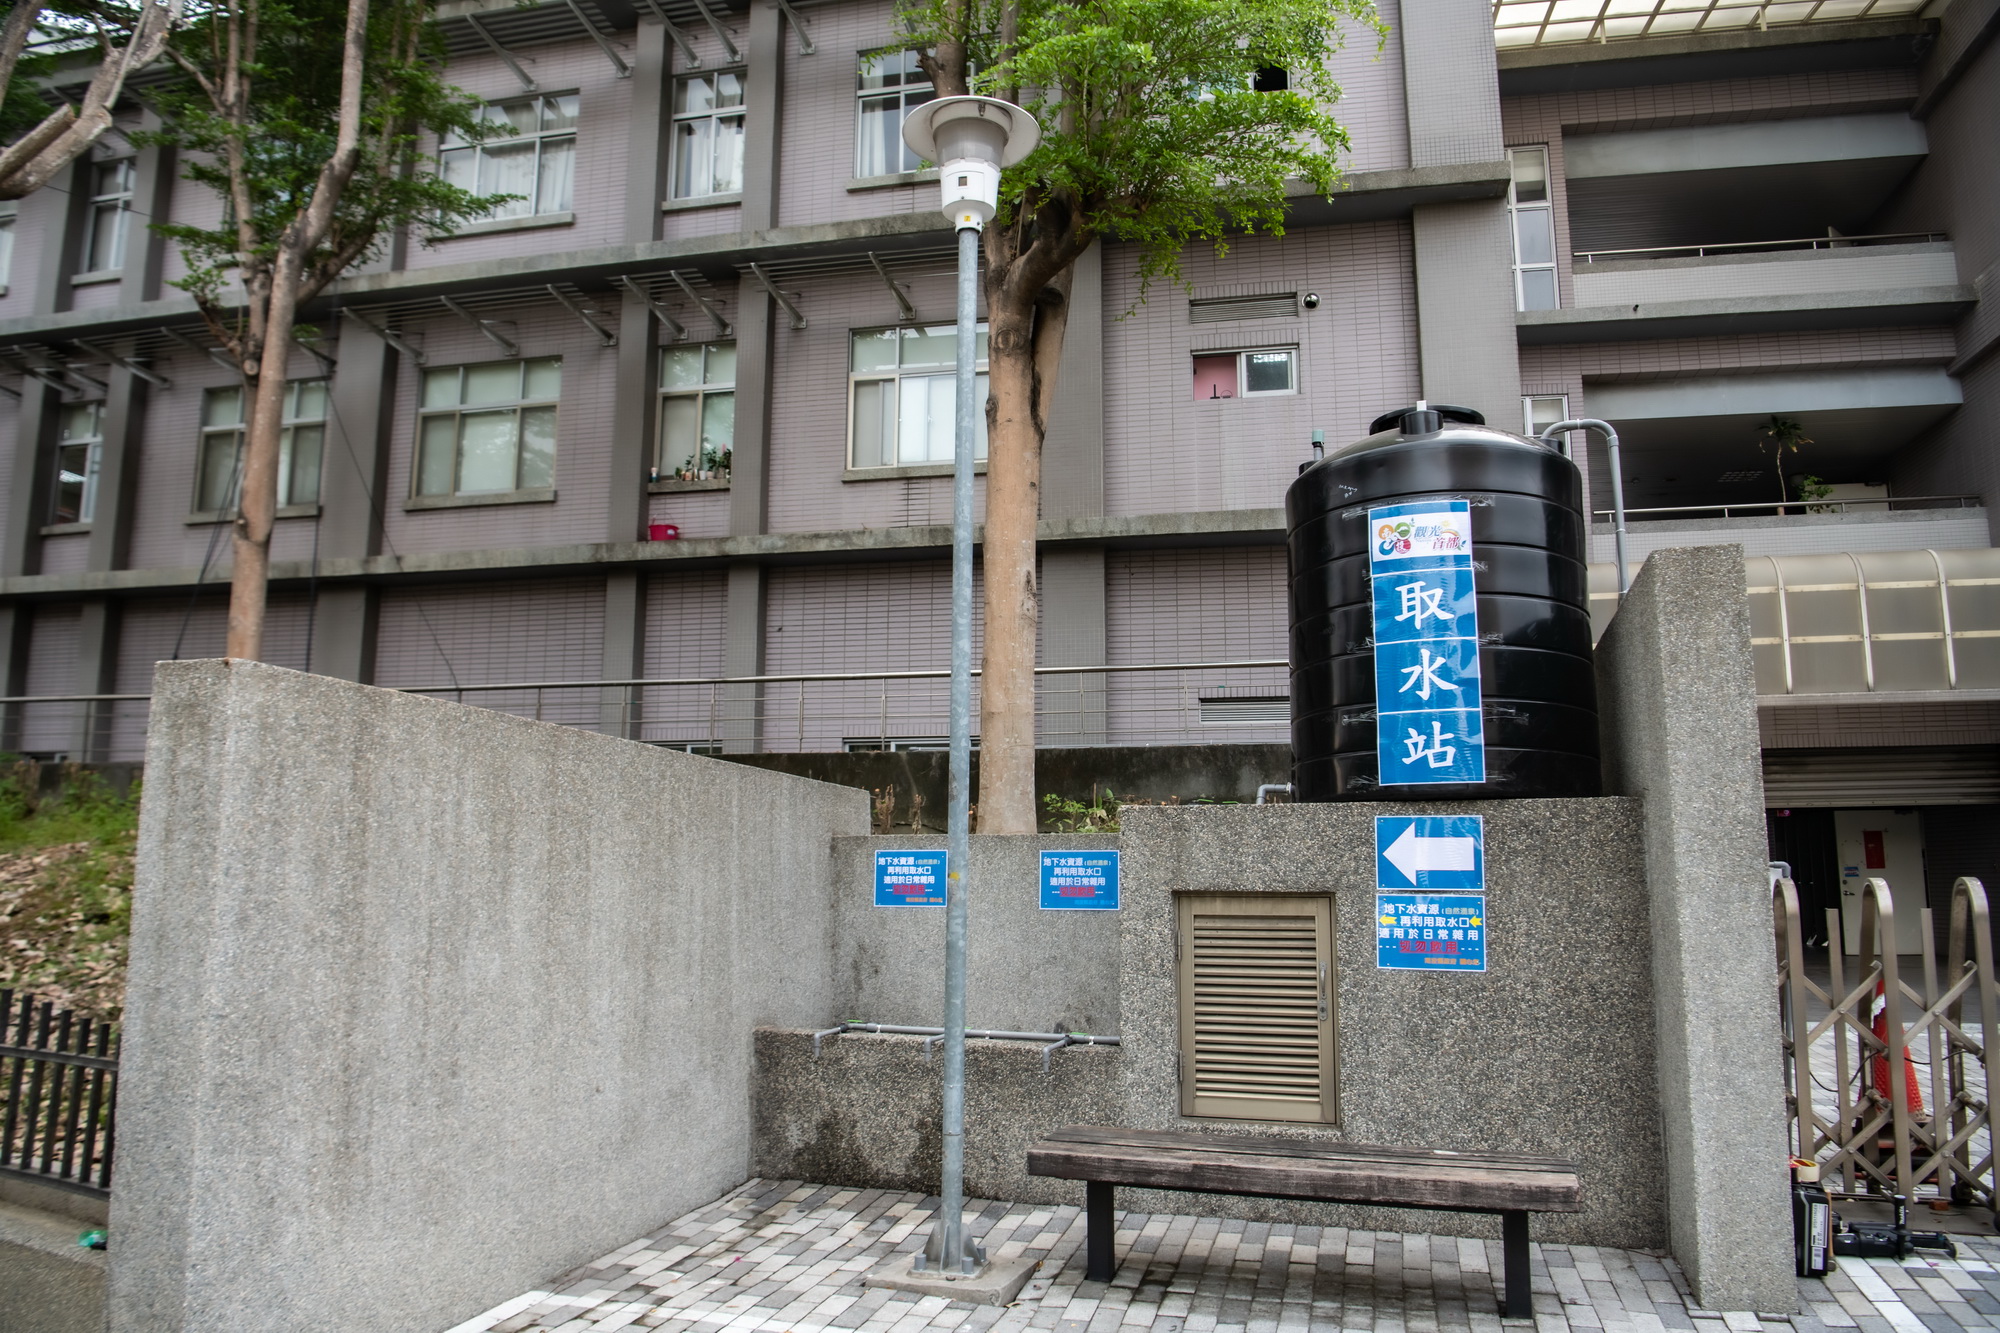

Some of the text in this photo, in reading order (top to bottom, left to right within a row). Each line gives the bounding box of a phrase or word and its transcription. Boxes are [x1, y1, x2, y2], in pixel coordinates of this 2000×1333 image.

[1414, 525, 1441, 538] 觀光
[1433, 536, 1460, 551] 首都
[887, 866, 932, 875] 再利用取水口
[1053, 867, 1102, 876] 再利用取水口
[1400, 916, 1470, 927] 再利用取水口
